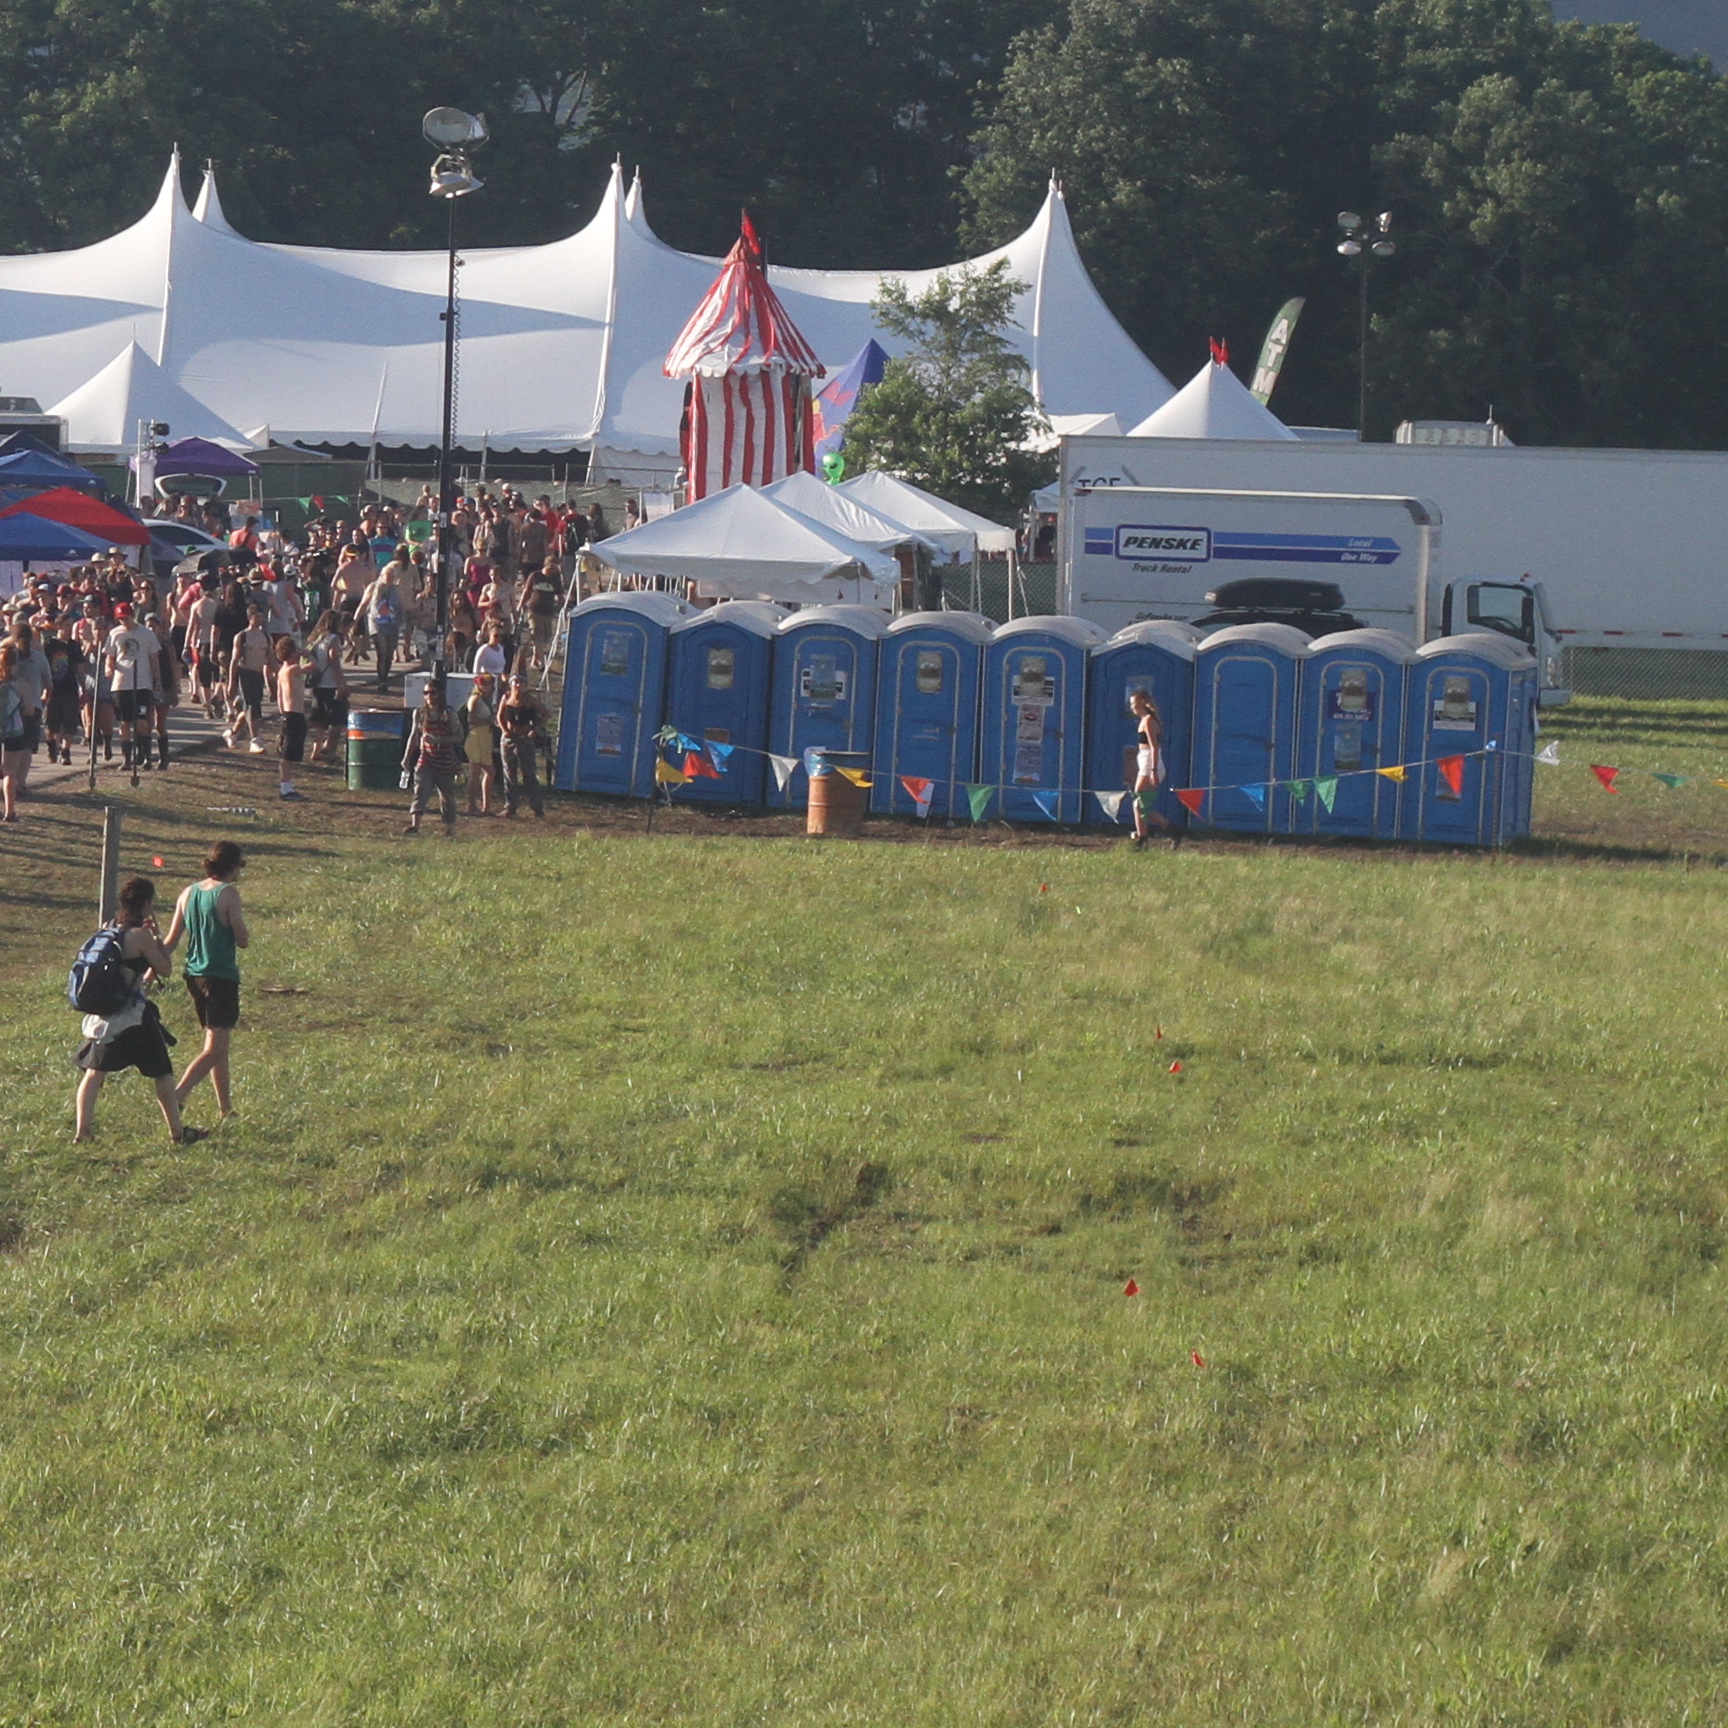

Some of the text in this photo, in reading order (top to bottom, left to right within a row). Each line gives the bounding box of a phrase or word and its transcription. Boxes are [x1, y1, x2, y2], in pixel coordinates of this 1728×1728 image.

[1253, 318, 1288, 395] ATM
[1123, 536, 1203, 550] PENSKE
[1132, 562, 1193, 574] Truck Rental
